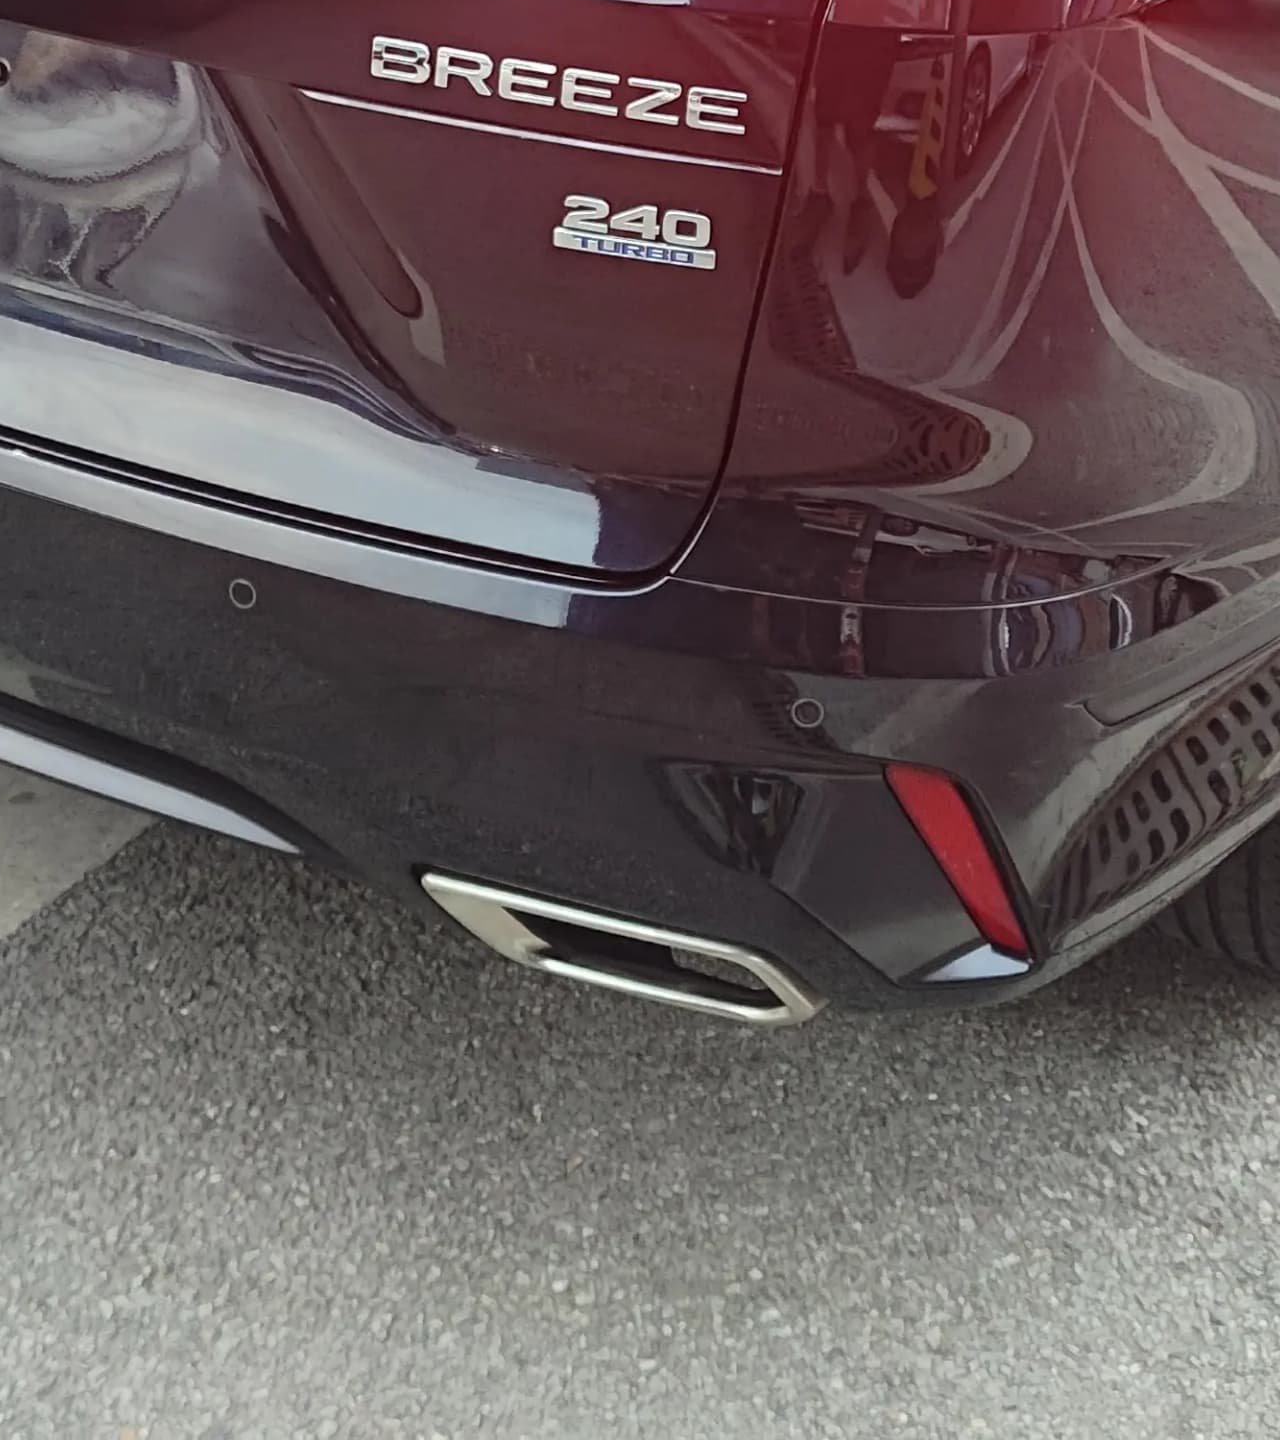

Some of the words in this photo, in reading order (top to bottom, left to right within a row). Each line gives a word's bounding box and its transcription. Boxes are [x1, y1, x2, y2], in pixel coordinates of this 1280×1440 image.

[369, 35, 749, 136] BREEZE
[562, 194, 712, 249] 240
[572, 234, 695, 265] TURBO
